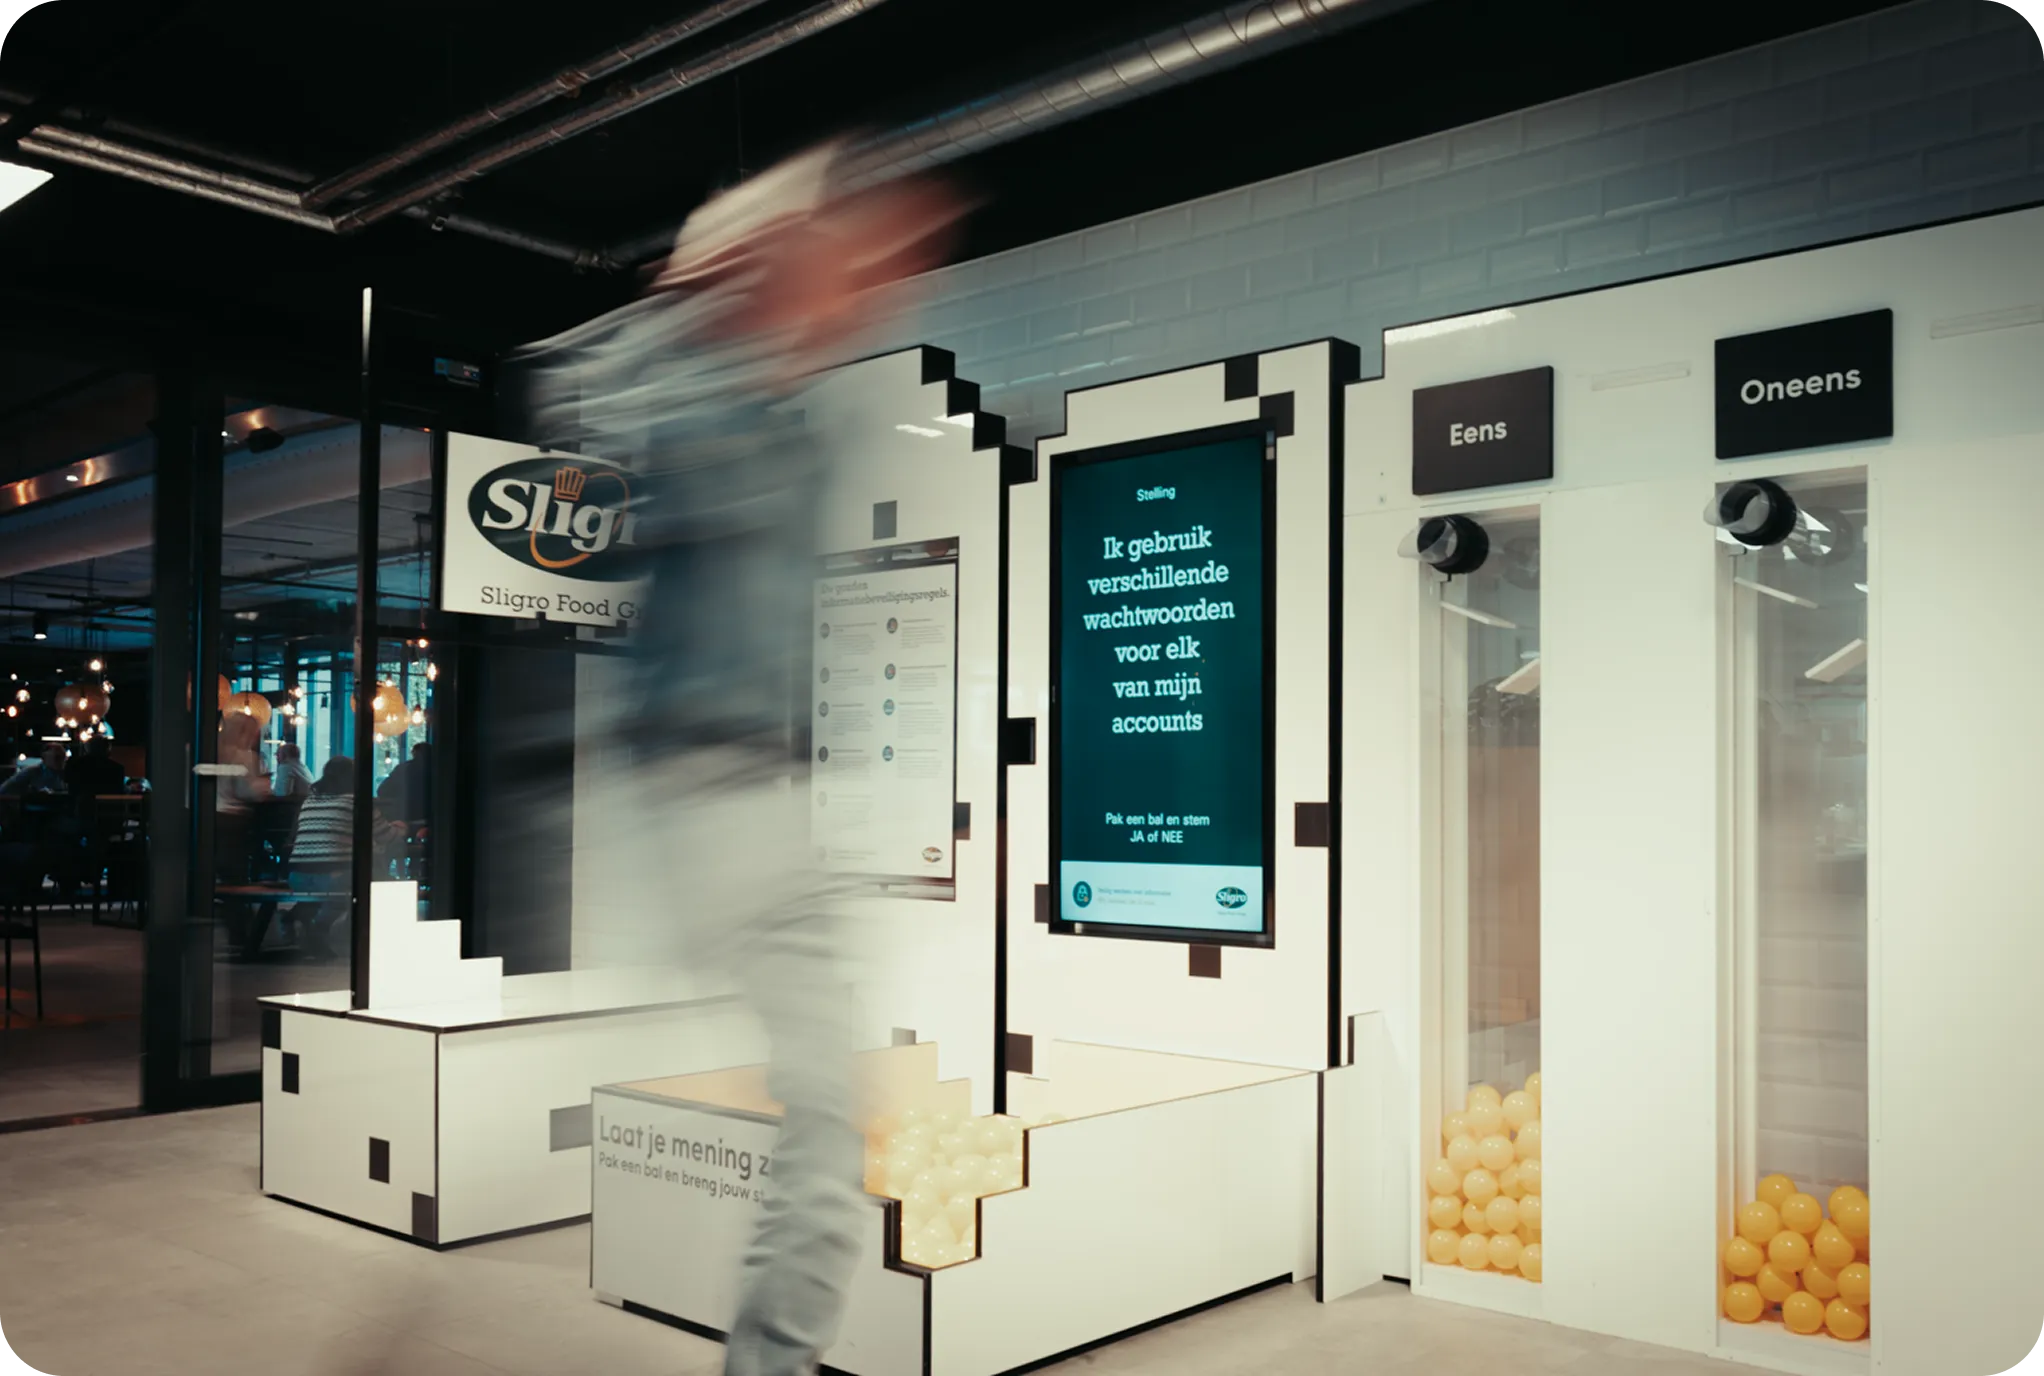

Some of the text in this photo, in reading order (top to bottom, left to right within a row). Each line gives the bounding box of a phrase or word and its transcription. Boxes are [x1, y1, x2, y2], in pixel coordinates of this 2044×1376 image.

[1740, 367, 1862, 406] Oneens
[1449, 416, 1508, 447] Eens
[1136, 486, 1176, 502] Stelling
[482, 478, 637, 553] Sligr
[1103, 525, 1212, 562] Ik gebruik
[1088, 560, 1229, 595] verschillende
[481, 586, 641, 619] Sligro Food G
[1083, 598, 1235, 630] wachtwoorden
[1114, 636, 1200, 662] voor elk
[1112, 672, 1202, 700] van mijn
[1112, 710, 1203, 734] accounts
[1105, 812, 1210, 826] Pak een bal en stem
[1130, 830, 1184, 843] JA of NEE
[1216, 889, 1247, 903] Sligro
[599, 1115, 770, 1181] Laat je mening z
[599, 1152, 619, 1168] Pak
[620, 1159, 642, 1175] een
[644, 1163, 662, 1180] bal
[665, 1169, 679, 1183] en
[682, 1171, 718, 1197] breng
[718, 1178, 750, 1200] jouw
